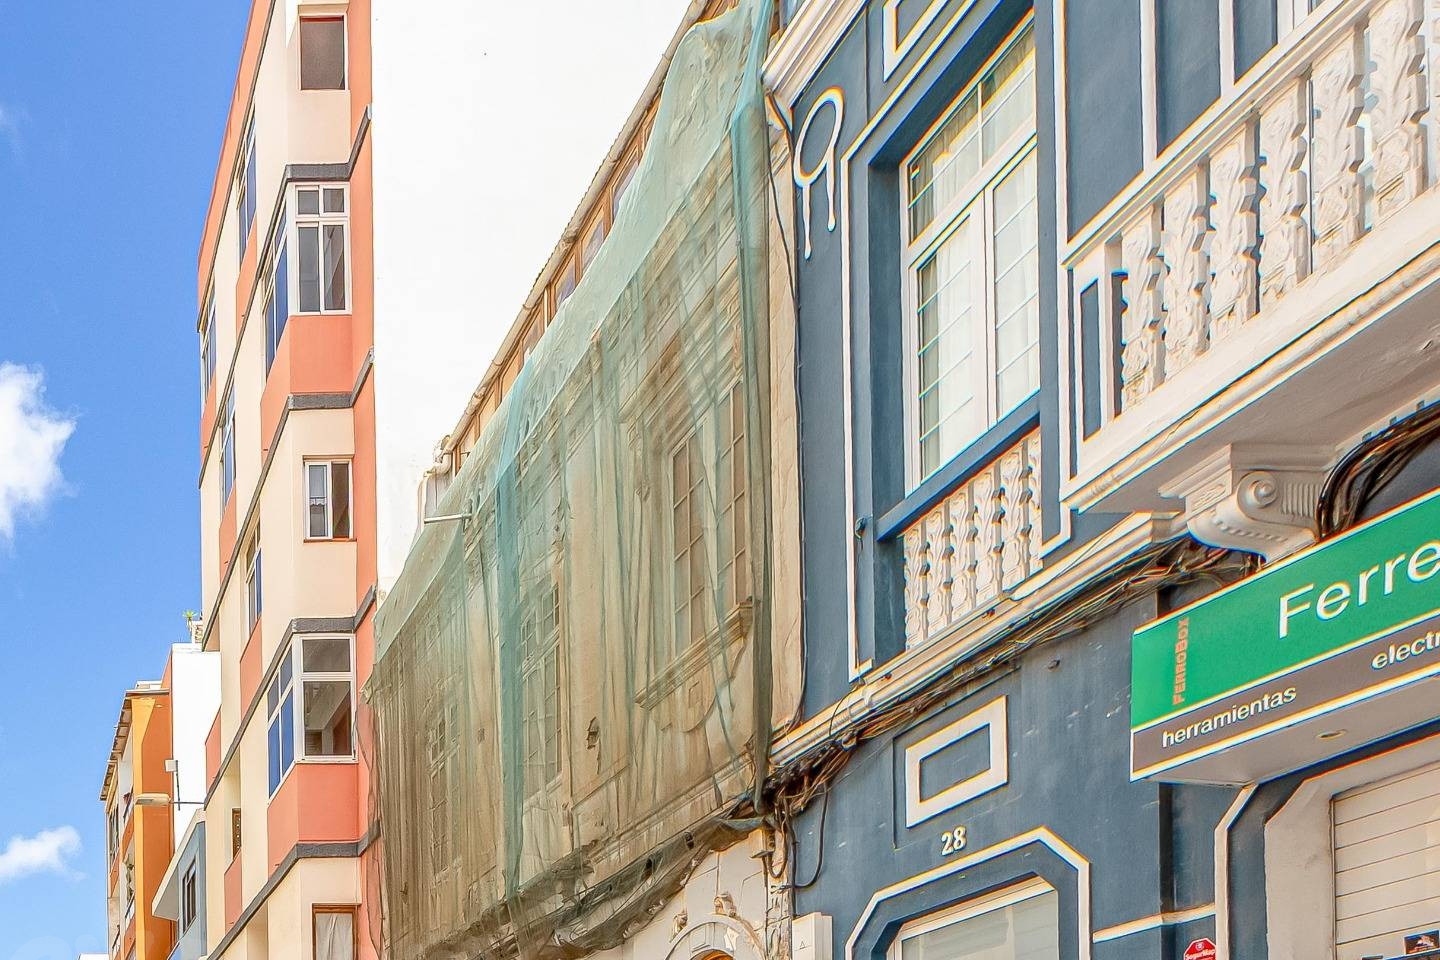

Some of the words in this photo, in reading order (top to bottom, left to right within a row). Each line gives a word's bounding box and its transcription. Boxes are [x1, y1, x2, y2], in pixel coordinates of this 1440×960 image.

[1172, 617, 1190, 705] FERROBOX
[1161, 686, 1298, 749] herramientas
[941, 826, 967, 856] 28
